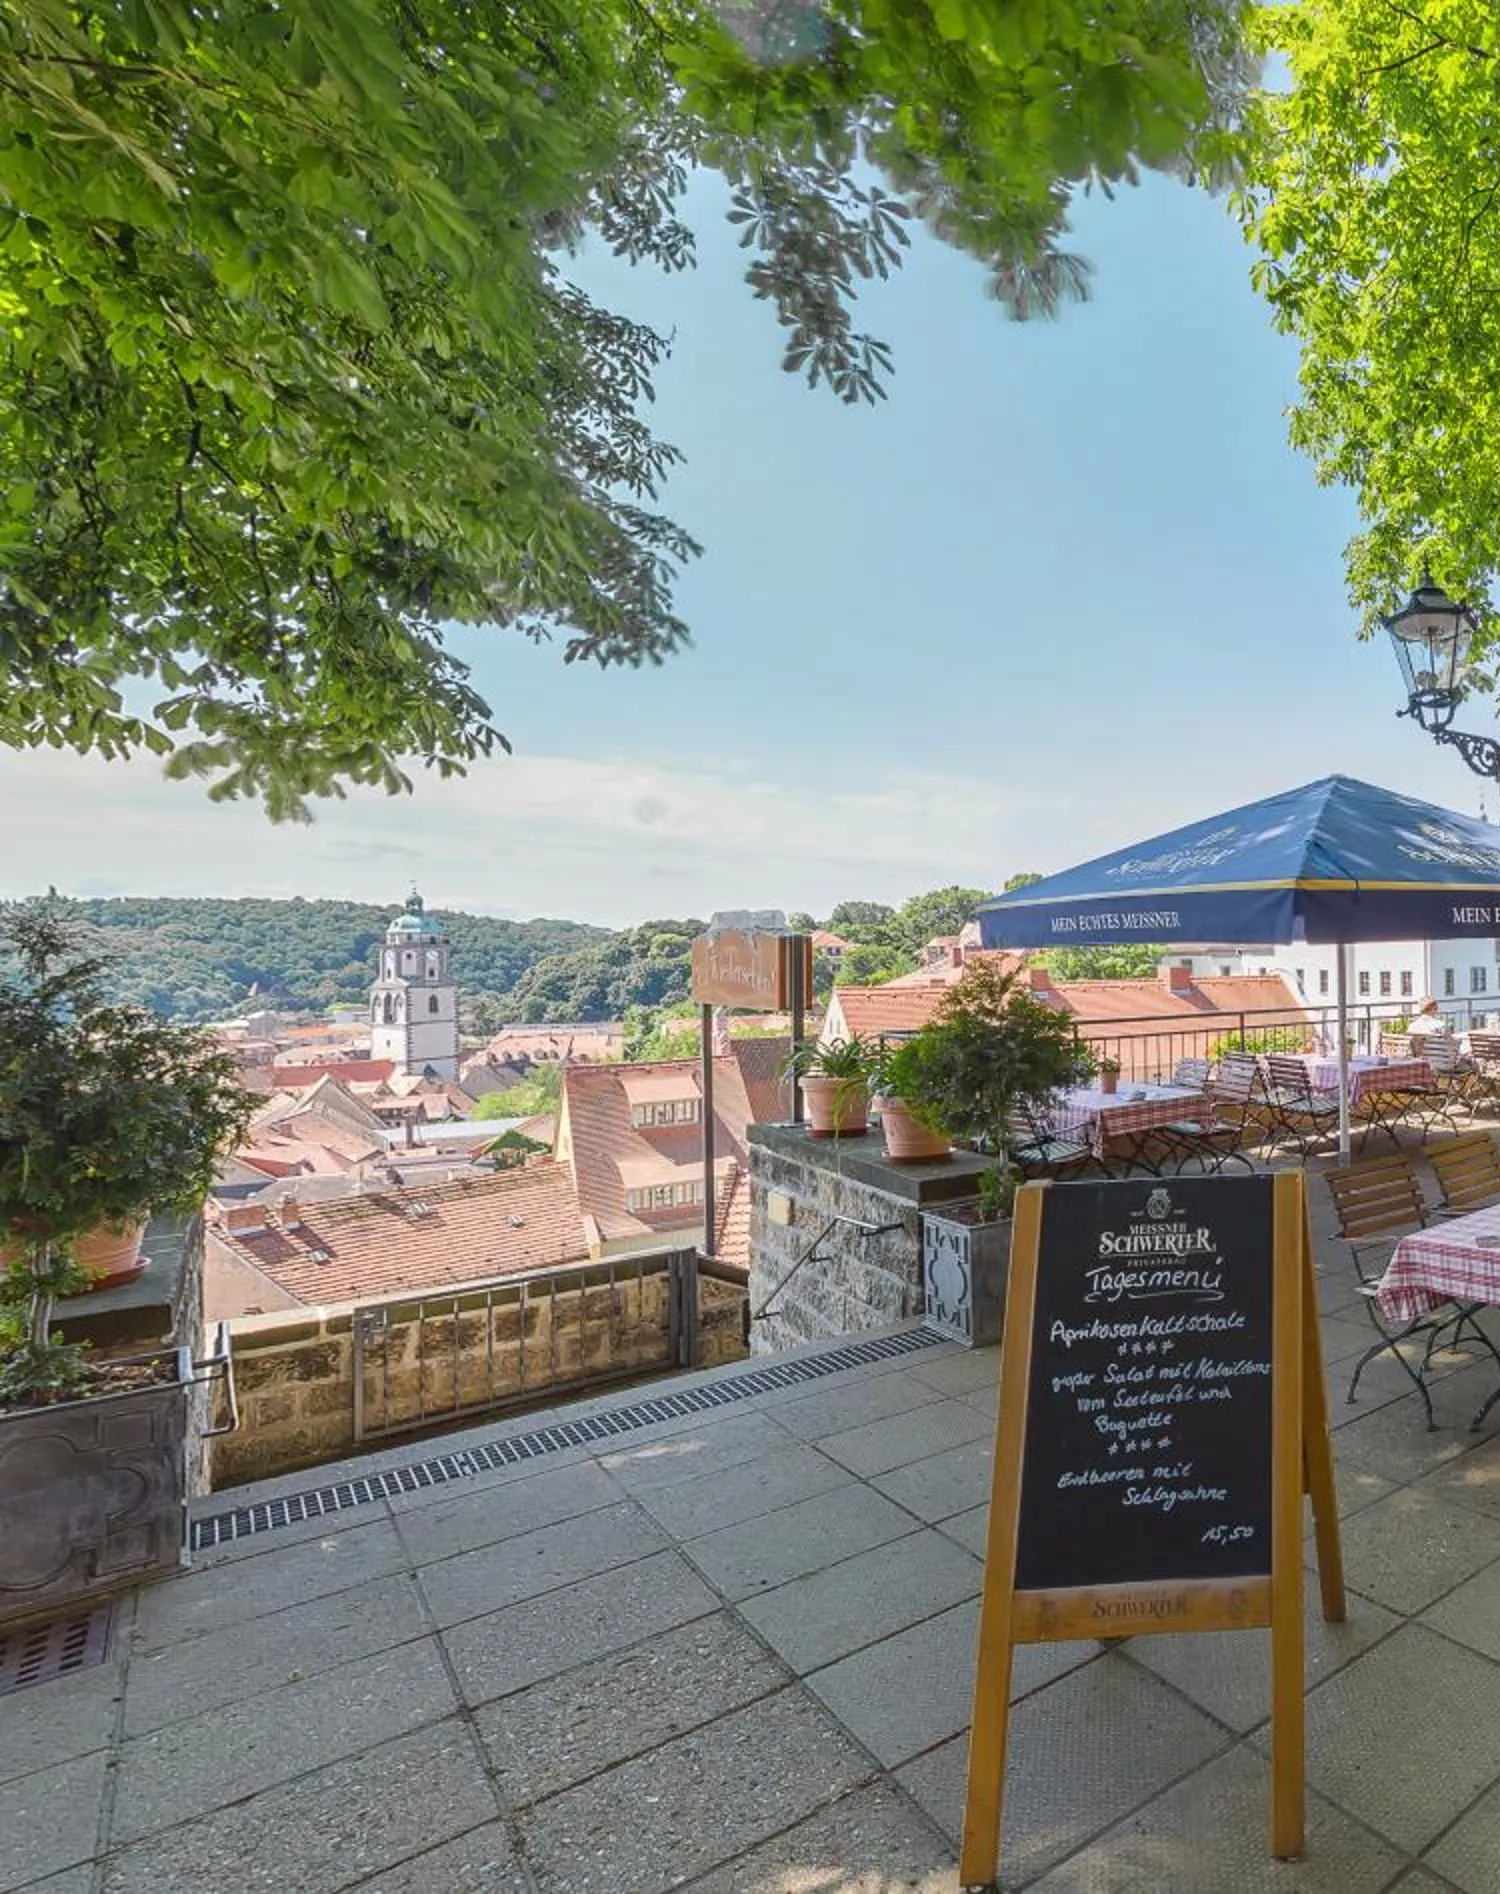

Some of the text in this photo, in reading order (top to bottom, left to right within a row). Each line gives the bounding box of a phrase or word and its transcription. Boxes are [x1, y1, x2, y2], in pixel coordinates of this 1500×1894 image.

[1452, 907, 1491, 923] MEIN
[1129, 1223, 1187, 1235] MEISSNER
[1099, 1228, 1217, 1256] SCHWERTER
[1103, 1363, 1156, 1384] Salat
[1159, 1361, 1193, 1379] mit
[1198, 1385, 1232, 1400] und
[1095, 1412, 1173, 1440] Baguette
[1057, 1462, 1193, 1489] Erdbeeren mit
[1201, 1525, 1254, 1545] 15,50
